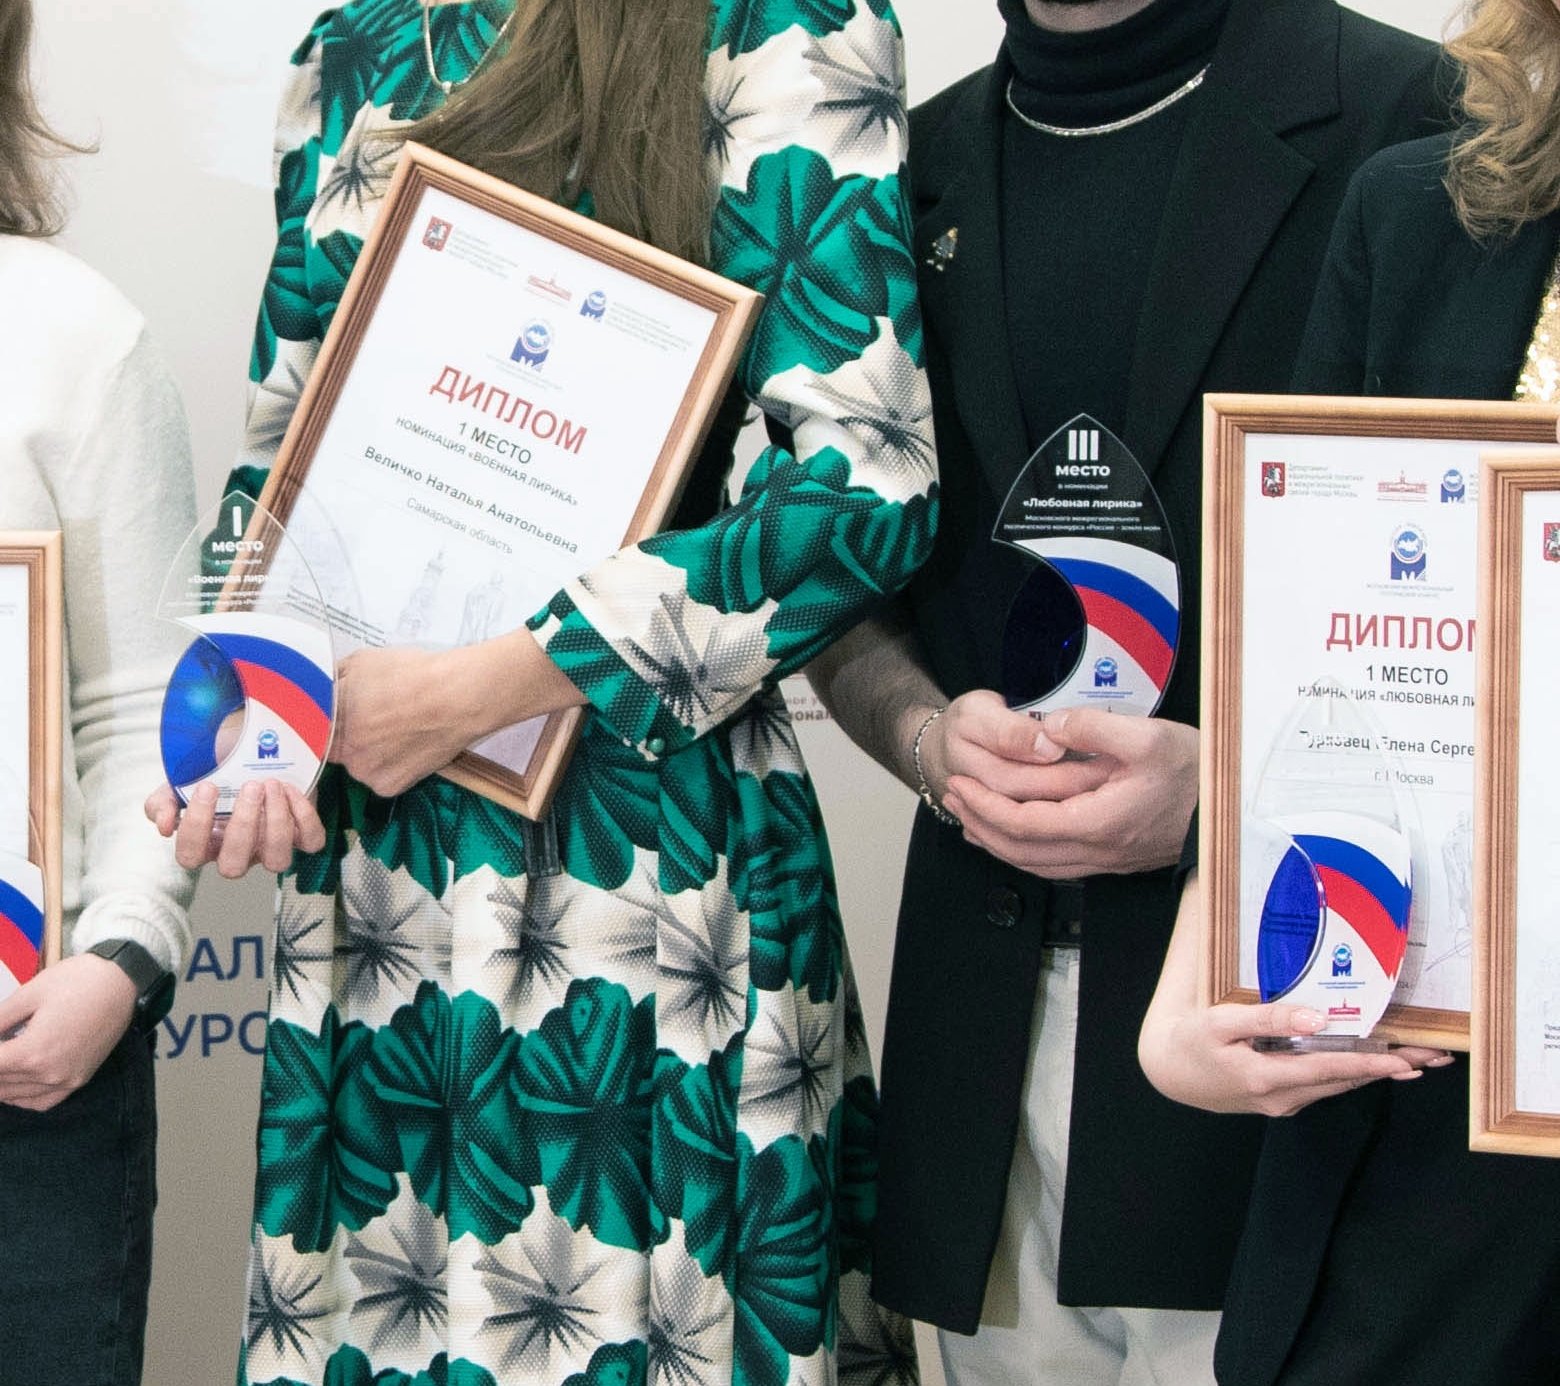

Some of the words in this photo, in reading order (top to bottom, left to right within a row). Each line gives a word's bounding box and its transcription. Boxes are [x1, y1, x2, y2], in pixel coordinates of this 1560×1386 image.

[428, 365, 588, 455] ДИПЛОМ
[459, 422, 468, 436] 1
[470, 426, 532, 465] МЕСТО
[1067, 429, 1100, 461] III
[395, 416, 467, 456] НОМИНАЦИЯ
[467, 450, 528, 484] «ВОЕННАЯ
[527, 476, 578, 506] ЛИРИКА»
[1055, 464, 1111, 478] место
[364, 445, 423, 482] Величко
[425, 473, 484, 510] Наталья
[485, 503, 578, 554] Анатольевна
[1022, 497, 1091, 509] «Любовная
[1091, 499, 1143, 511] лирика»
[406, 496, 468, 534] Самарская
[468, 528, 513, 555] область
[211, 540, 265, 553] место
[1366, 665, 1374, 681] 1
[1382, 666, 1449, 685] МЕСТО
[1380, 690, 1459, 706] «ЛЮБОВНАЯ
